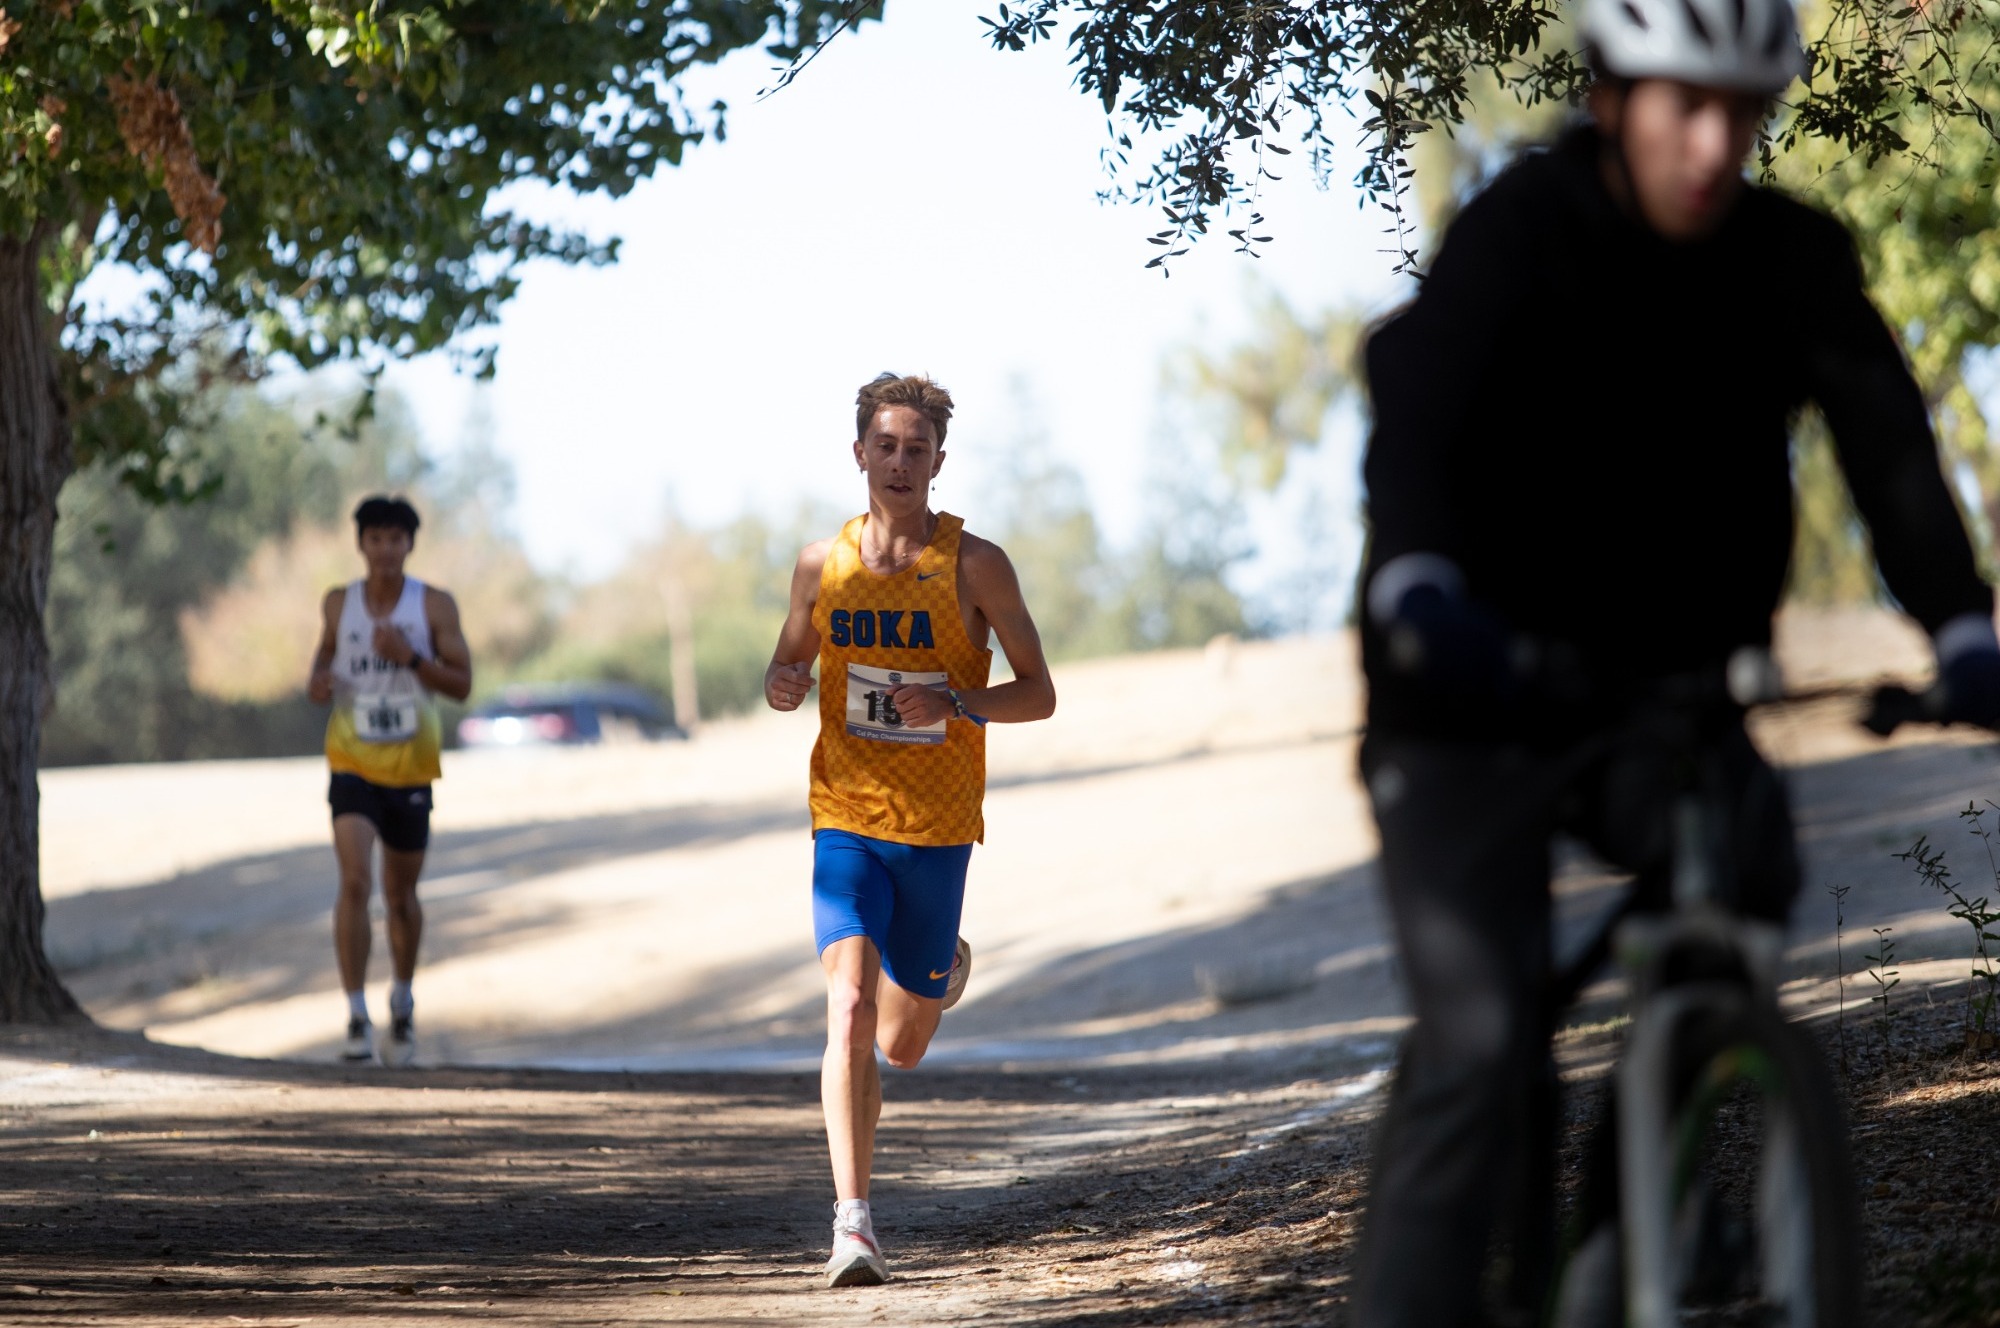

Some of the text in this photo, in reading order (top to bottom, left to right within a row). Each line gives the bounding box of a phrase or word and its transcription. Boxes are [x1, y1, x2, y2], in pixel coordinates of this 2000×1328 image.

[830, 609, 935, 649] SOKA
[864, 690, 903, 725] 19
[856, 729, 931, 743] Cal Pac Championships
